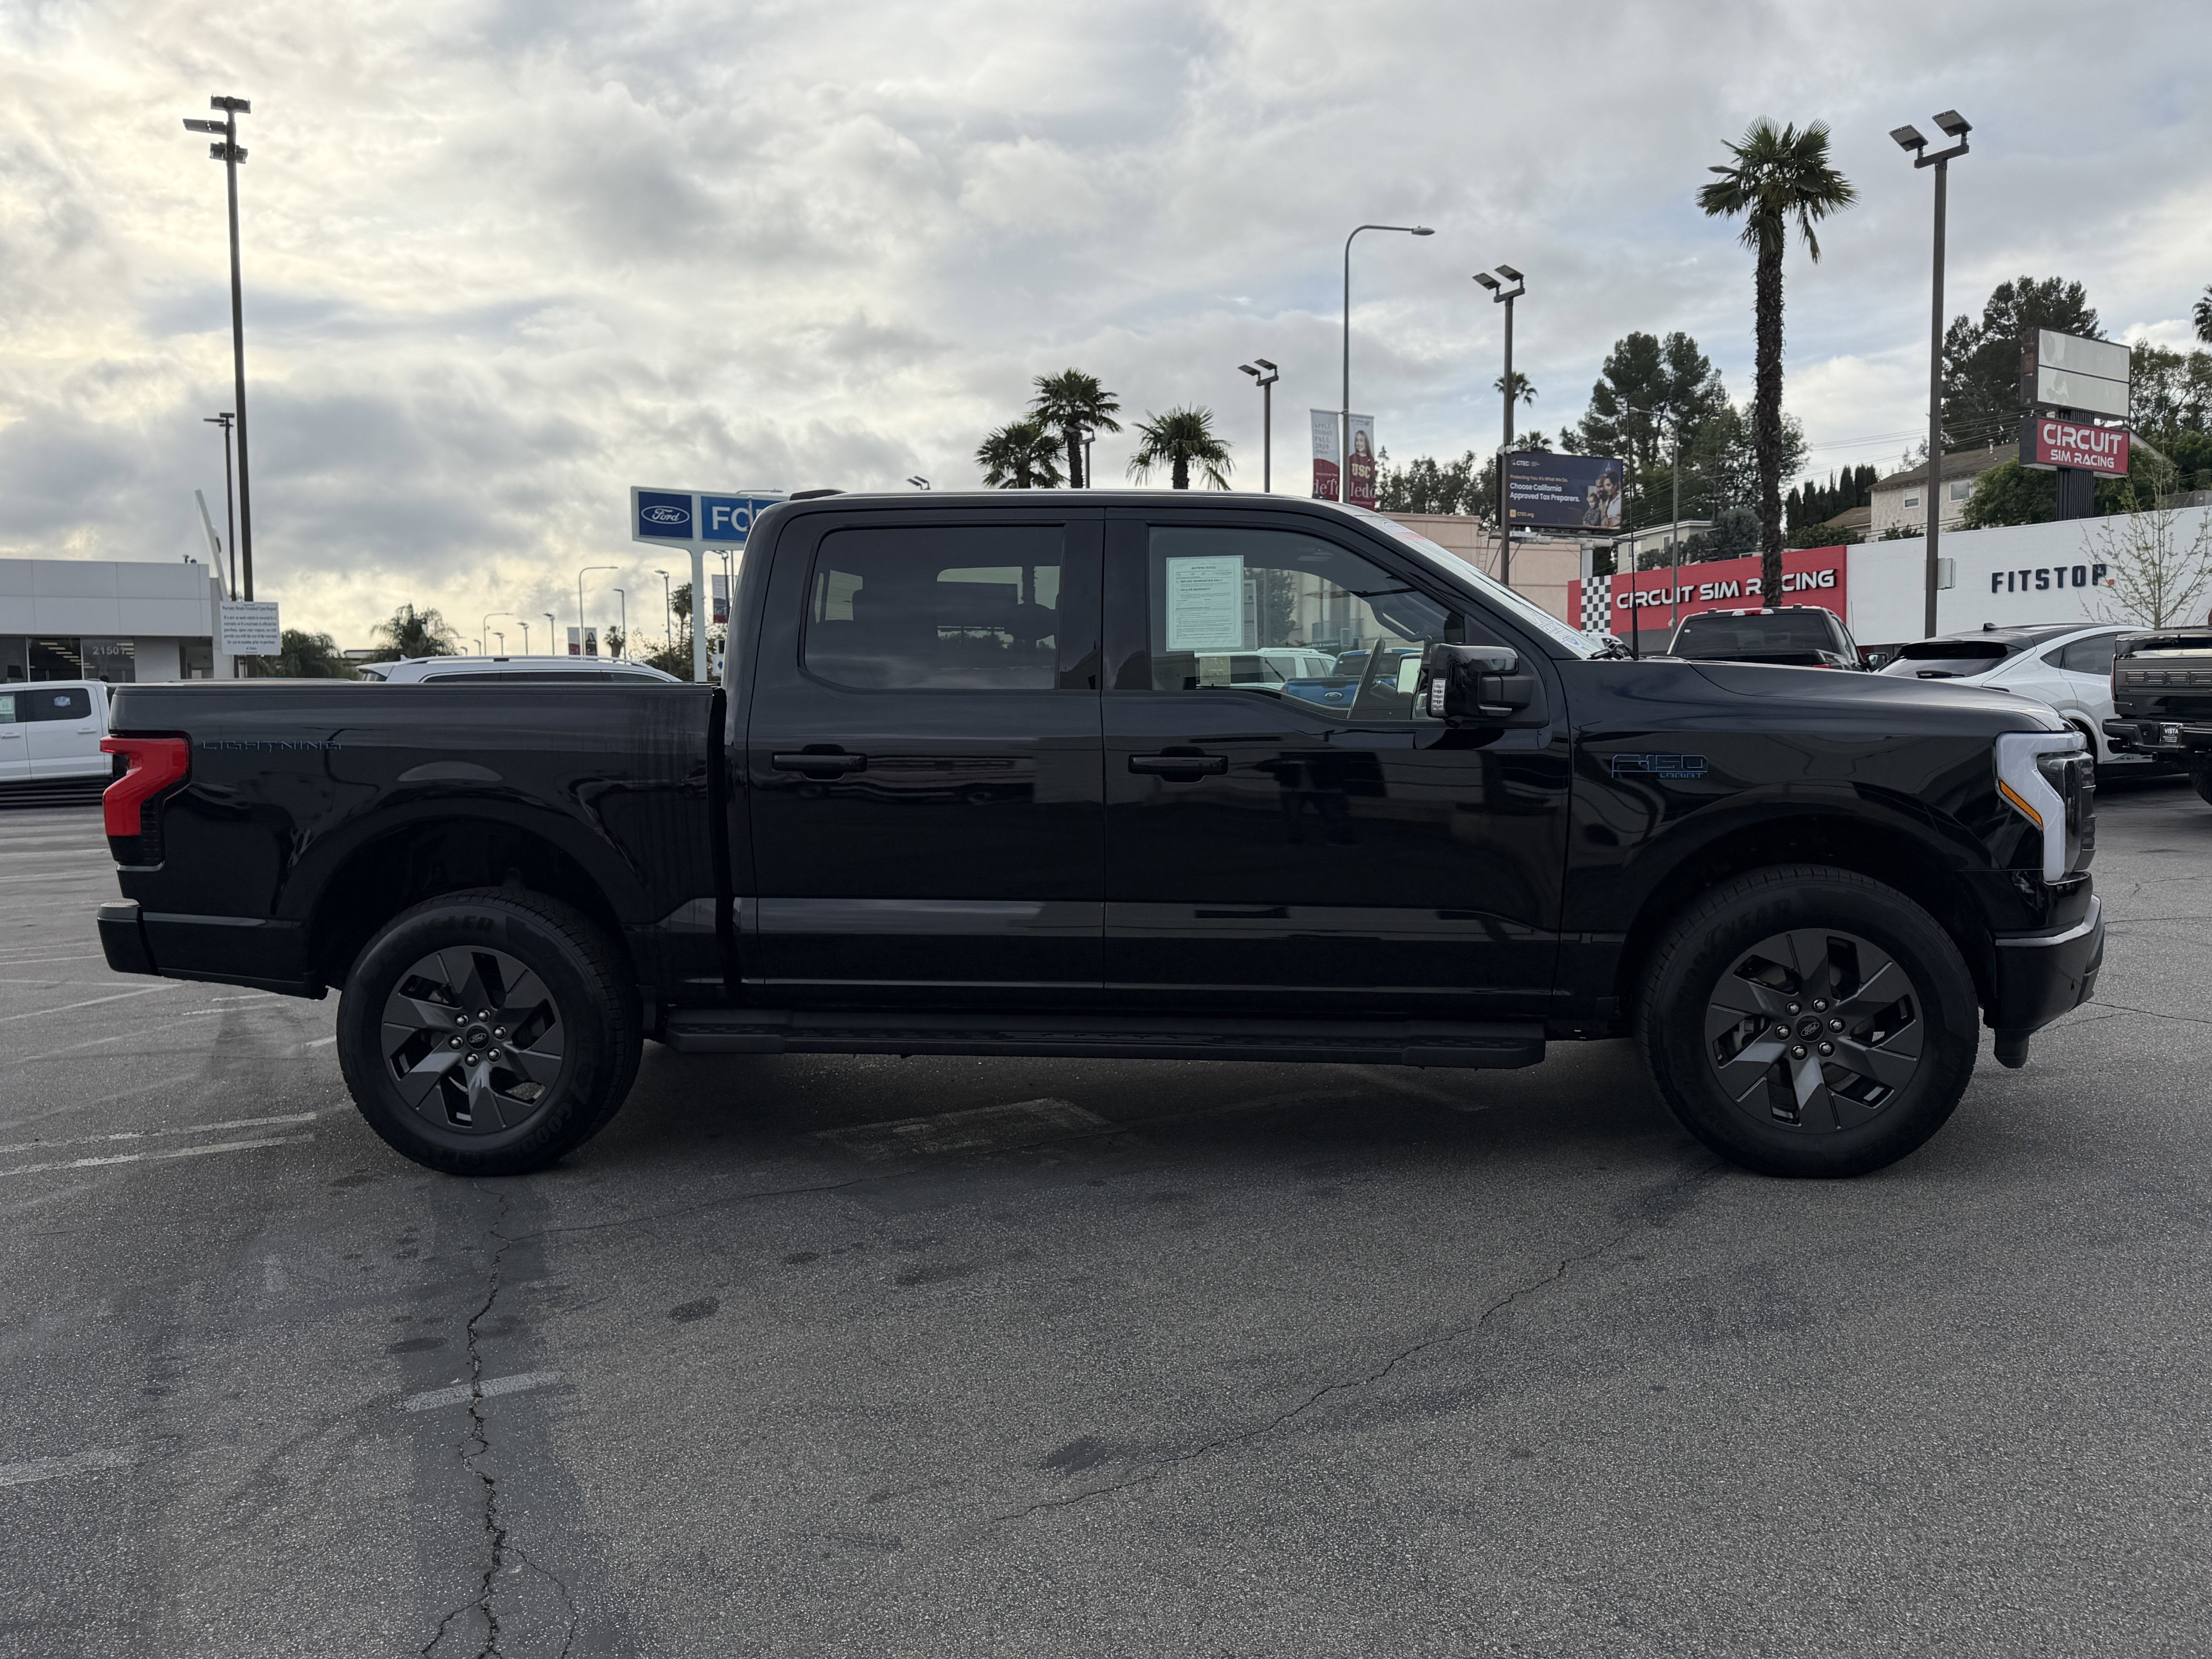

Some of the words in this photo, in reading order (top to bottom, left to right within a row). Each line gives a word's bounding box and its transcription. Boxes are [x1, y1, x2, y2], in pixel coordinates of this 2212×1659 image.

[2043, 423, 2122, 454] CIRCUIT
[2051, 449, 2071, 462] SIM
[2075, 452, 2114, 469] RACING
[1352, 463, 1371, 479] USC
[1510, 491, 1539, 500] Approved
[1551, 494, 1580, 503] Preparers.
[652, 508, 680, 522] Ford
[1616, 585, 1695, 609] CIRCUIT
[1699, 580, 1740, 601] SIM
[1745, 569, 1835, 596] RCING
[93, 646, 124, 655] 21501
[2126, 672, 2212, 684] FORD
[203, 740, 342, 753] LIGHTNING
